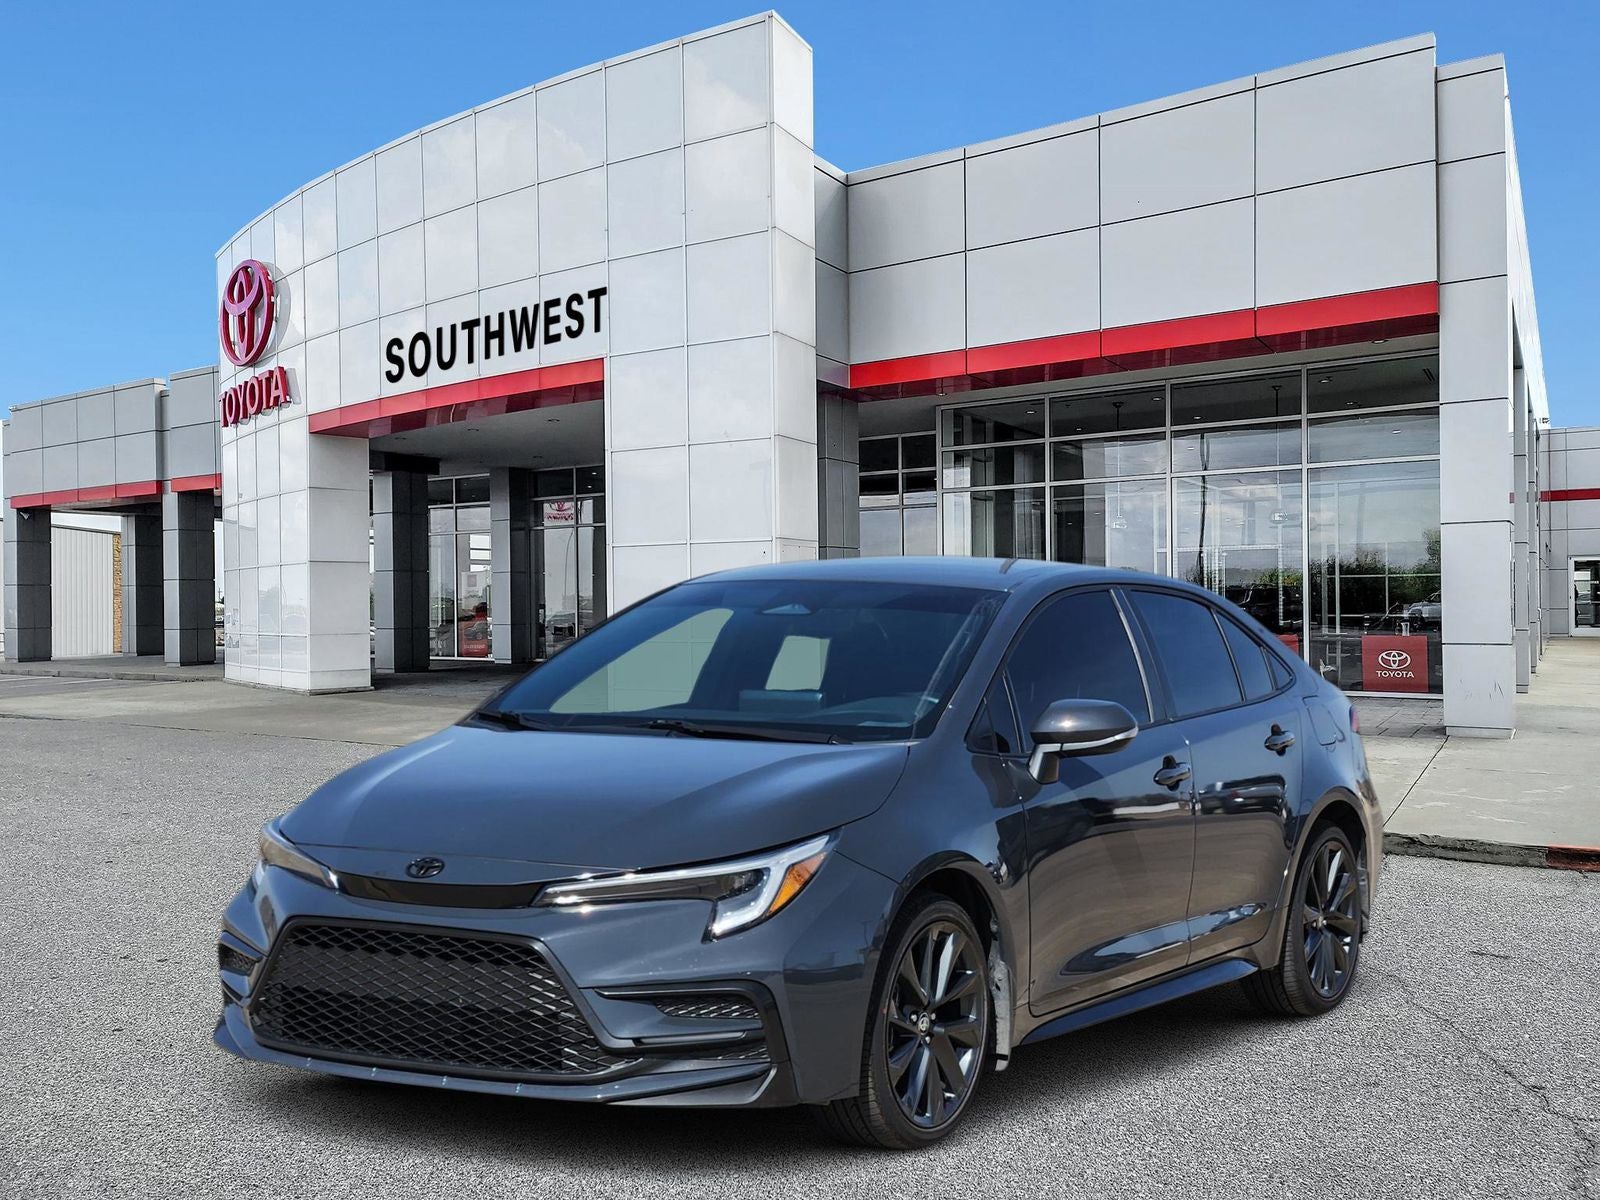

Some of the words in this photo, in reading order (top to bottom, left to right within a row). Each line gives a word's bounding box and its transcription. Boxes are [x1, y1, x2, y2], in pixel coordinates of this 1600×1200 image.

[385, 286, 608, 384] SOUTHWEST
[219, 366, 291, 427] TOYOTA
[1375, 670, 1415, 678] TOYOTA
